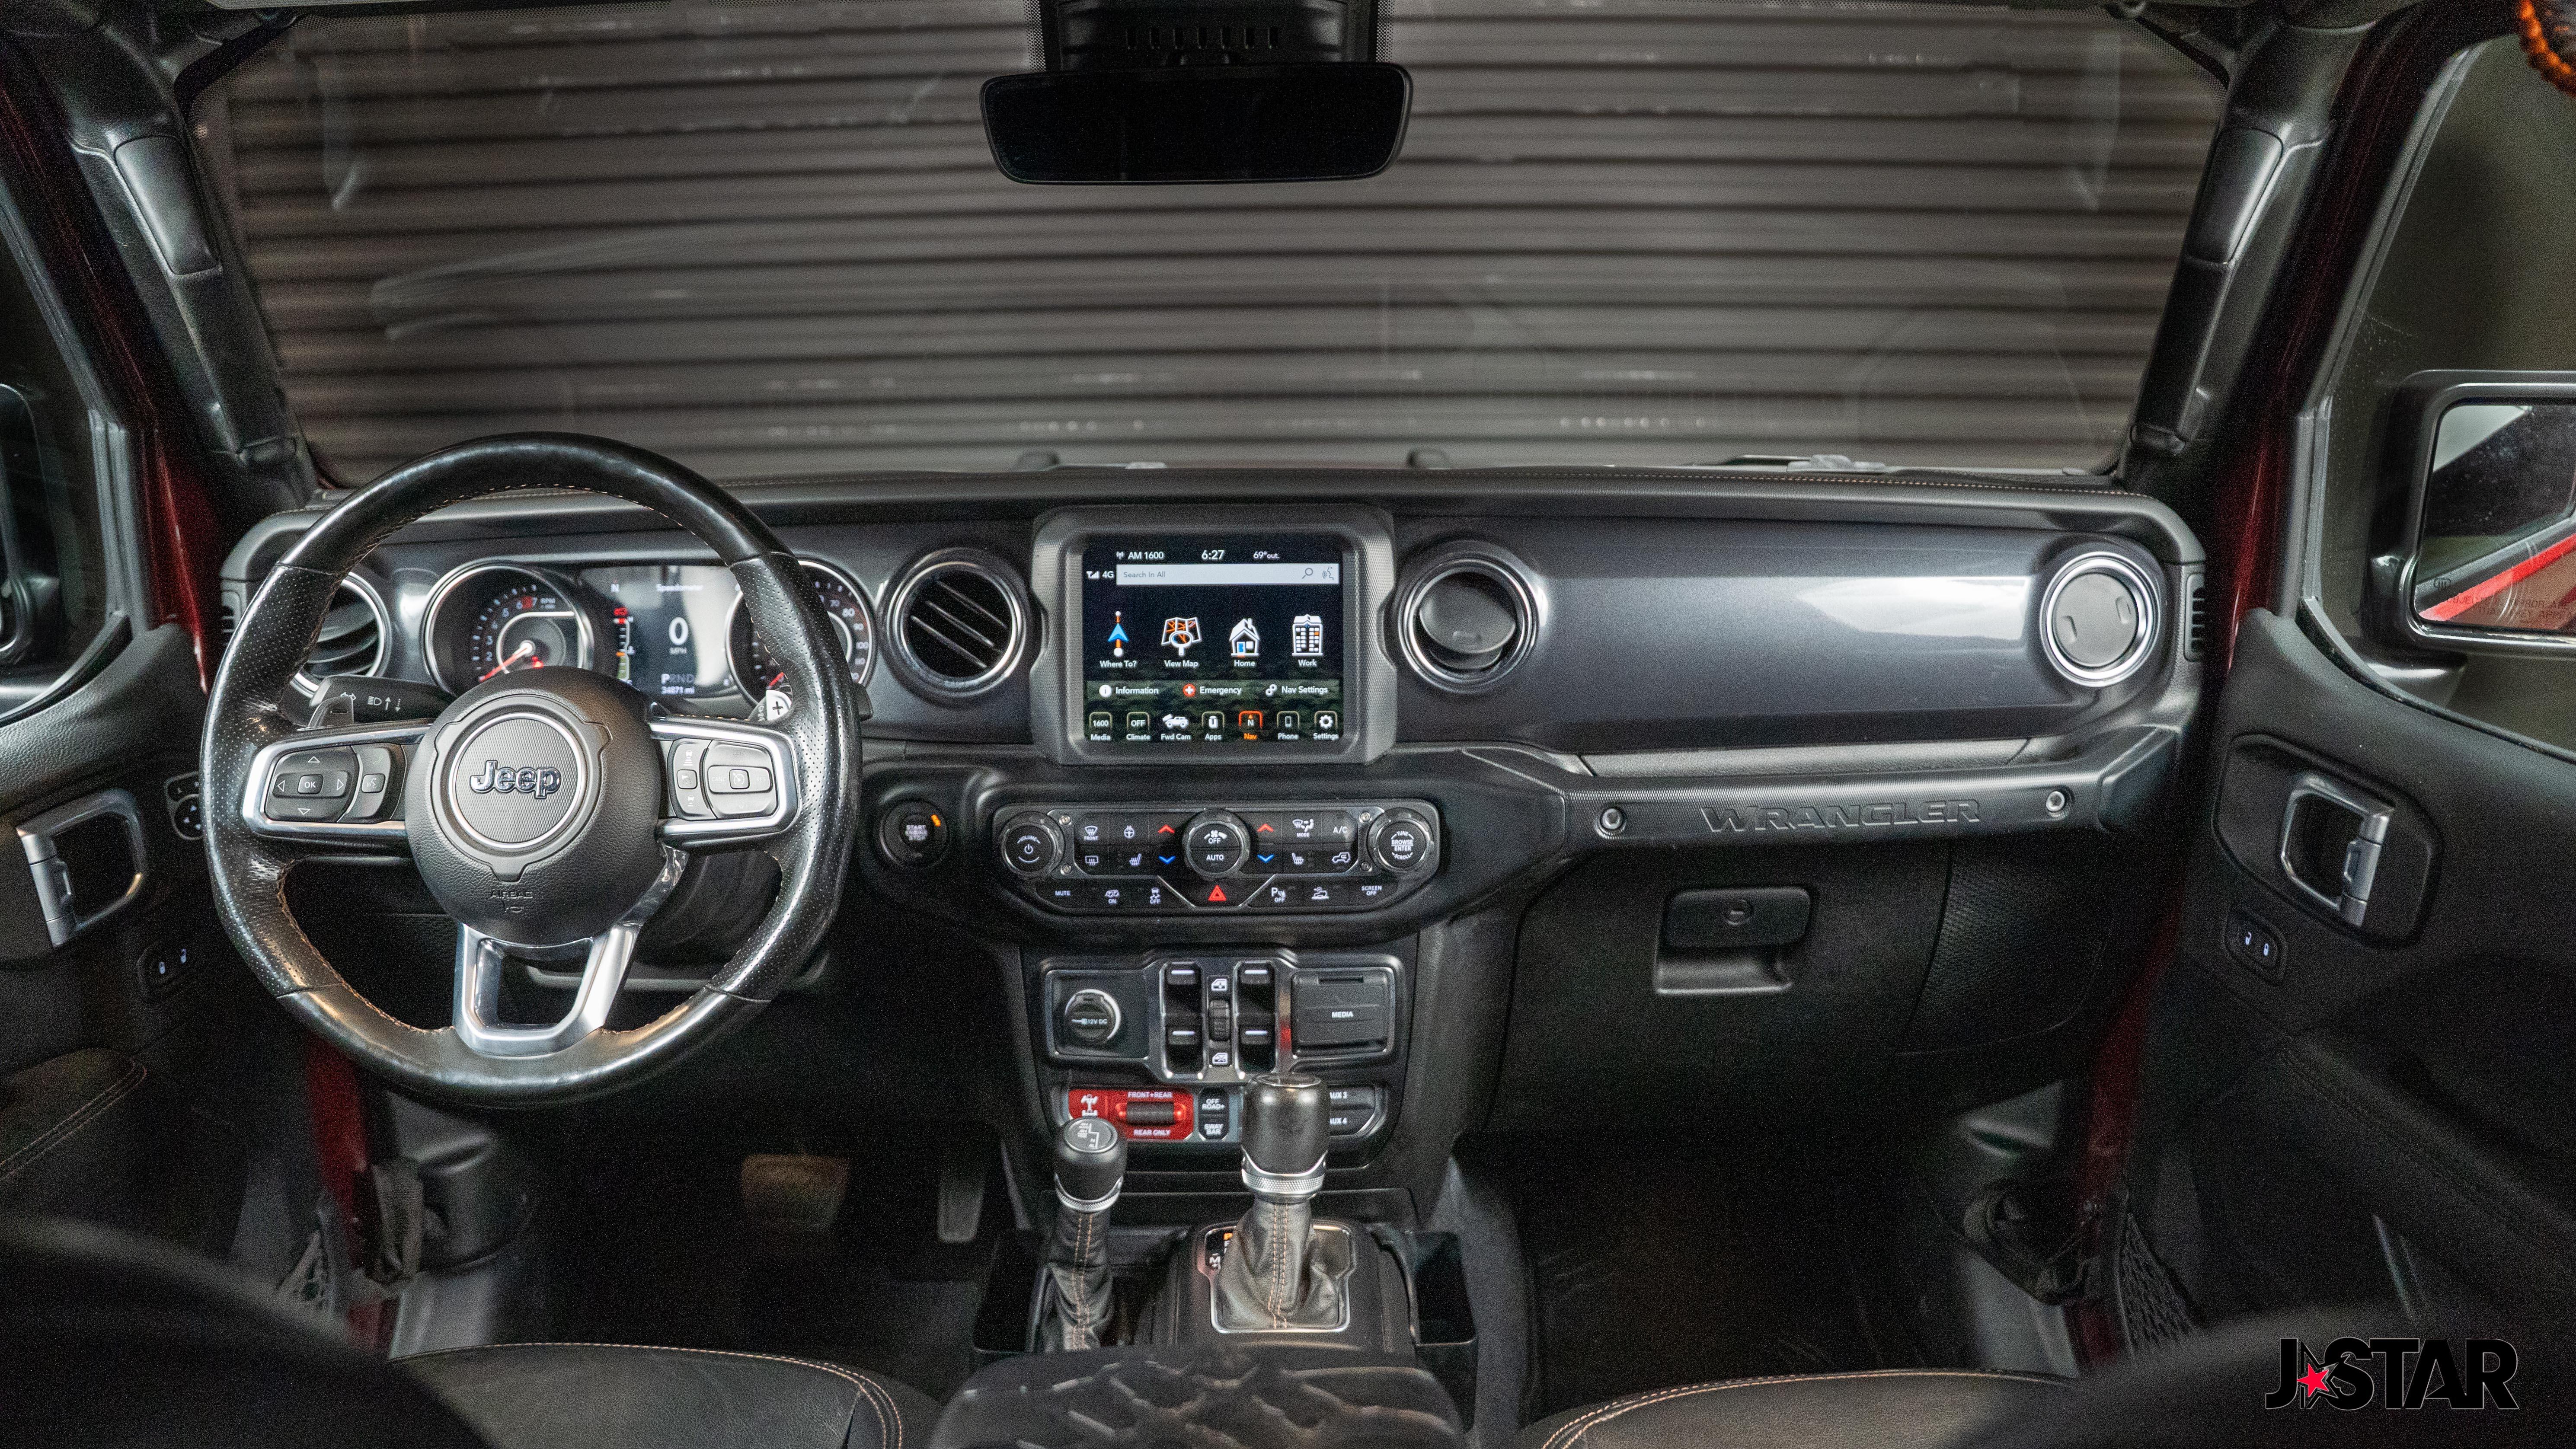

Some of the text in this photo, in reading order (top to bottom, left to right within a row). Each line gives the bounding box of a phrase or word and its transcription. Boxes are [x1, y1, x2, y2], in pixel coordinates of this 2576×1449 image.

[1144, 551, 1164, 559] 1600
[1201, 549, 1224, 560] 6:27
[842, 608, 856, 617] 80
[668, 616, 689, 645] 0
[486, 635, 493, 646] 3
[486, 651, 492, 662] 2
[1183, 660, 1199, 668] Map
[1115, 686, 1159, 694] Information
[1199, 686, 1242, 695] Emergency
[1298, 685, 1328, 695] Settings
[1313, 732, 1339, 740] Settings
[470, 760, 563, 799] Jeep
[1700, 799, 1980, 832] WRANGLER
